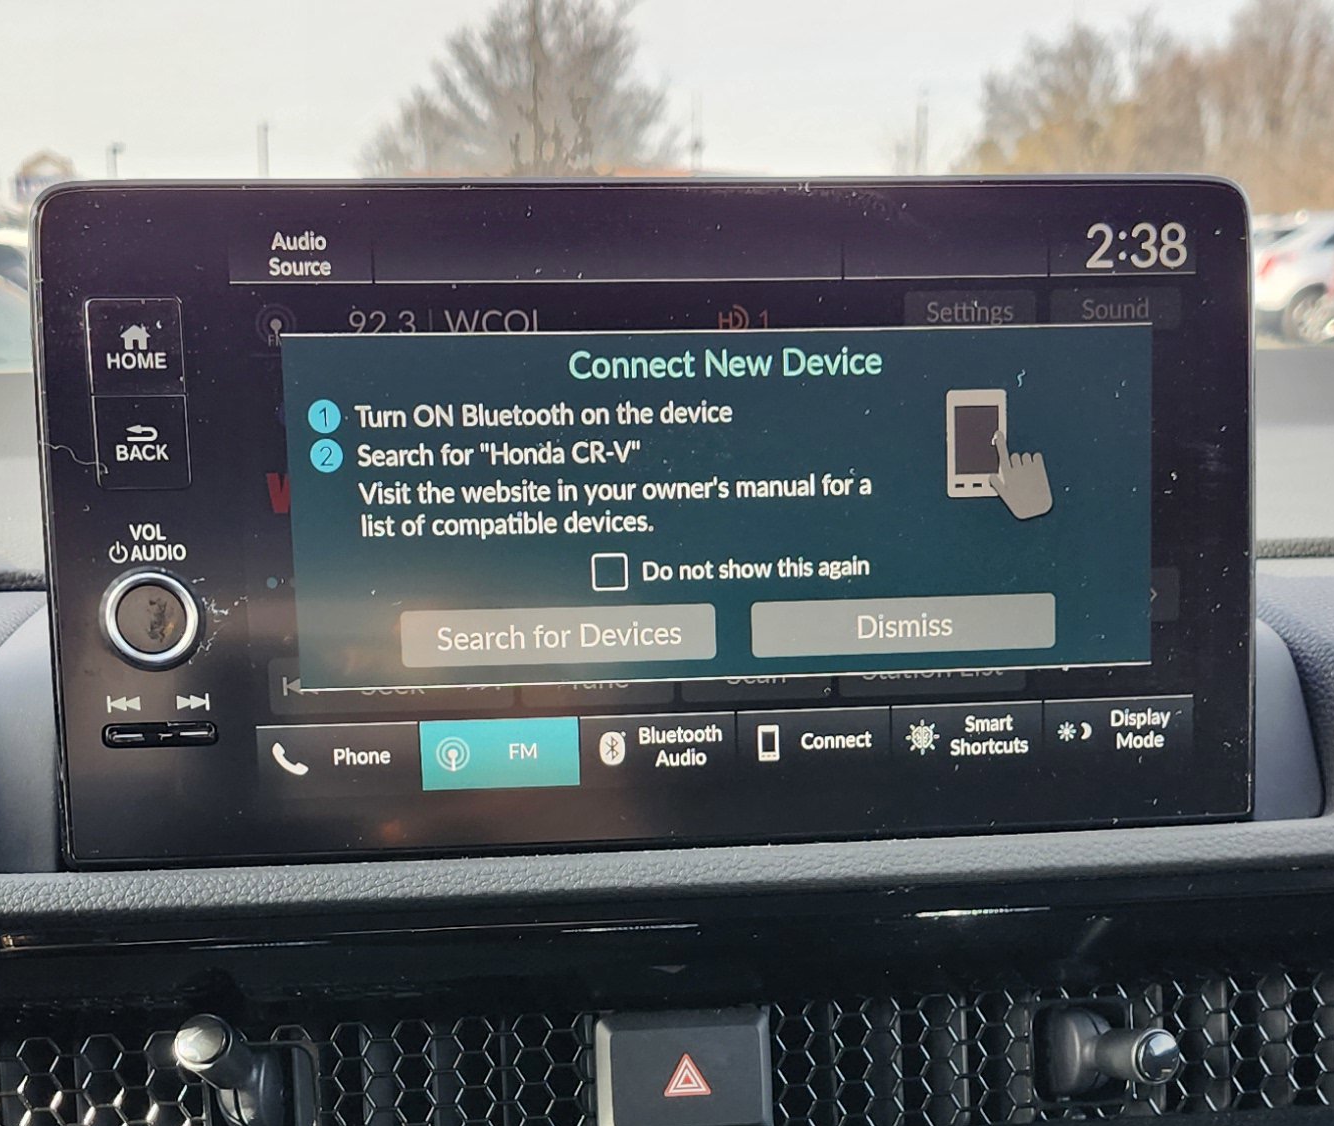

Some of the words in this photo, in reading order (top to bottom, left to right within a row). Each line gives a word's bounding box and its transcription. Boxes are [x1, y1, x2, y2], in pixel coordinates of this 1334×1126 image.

[271, 230, 327, 251] Audio
[1086, 221, 1188, 269] 2:38
[269, 257, 332, 277] Source
[926, 301, 1014, 325] Settings
[1082, 298, 1149, 321] Sound
[349, 310, 417, 333] 923
[106, 352, 168, 371] HOME
[568, 348, 696, 380] Connect
[704, 348, 773, 378] New
[782, 345, 883, 377] Device
[318, 406, 329, 428] 1
[354, 404, 407, 428] Turn
[413, 404, 454, 428] ON
[461, 402, 574, 427] Bluetooth
[580, 406, 610, 426] on
[616, 401, 654, 425] the
[659, 399, 733, 424] device
[116, 444, 170, 462] BACK
[319, 446, 334, 467] 2
[357, 443, 435, 467] Search
[440, 442, 474, 466] for
[480, 440, 565, 466] "Honda
[571, 439, 641, 464] CR-V"
[358, 481, 412, 506] Visit
[417, 480, 456, 504] the
[461, 479, 551, 503] website
[557, 478, 578, 501] in
[584, 482, 636, 506] your
[641, 476, 730, 501] owner's
[735, 473, 816, 499] manual
[821, 472, 854, 497] for
[858, 478, 873, 496] a
[129, 523, 167, 542] VOL
[361, 514, 395, 537] list
[401, 513, 426, 536] of
[431, 511, 558, 540] compatible
[563, 509, 655, 534] devices.
[130, 544, 187, 563] AUDIO
[642, 561, 673, 582] Do
[678, 559, 714, 580] not
[718, 556, 772, 579] show
[776, 555, 814, 578] this
[817, 555, 870, 581] again
[436, 625, 526, 651] Search
[532, 624, 572, 649] for
[579, 621, 683, 648] Devices
[857, 612, 954, 640] Dismiss
[964, 713, 1015, 734] Smart
[1110, 707, 1172, 729] Display
[638, 724, 723, 747] Bluetooth
[800, 730, 873, 751] Connect
[950, 735, 1030, 758] Shortcuts
[1115, 731, 1167, 751] Mode
[333, 746, 392, 767] Phone
[508, 742, 539, 761] FM
[654, 747, 708, 767] Audio
